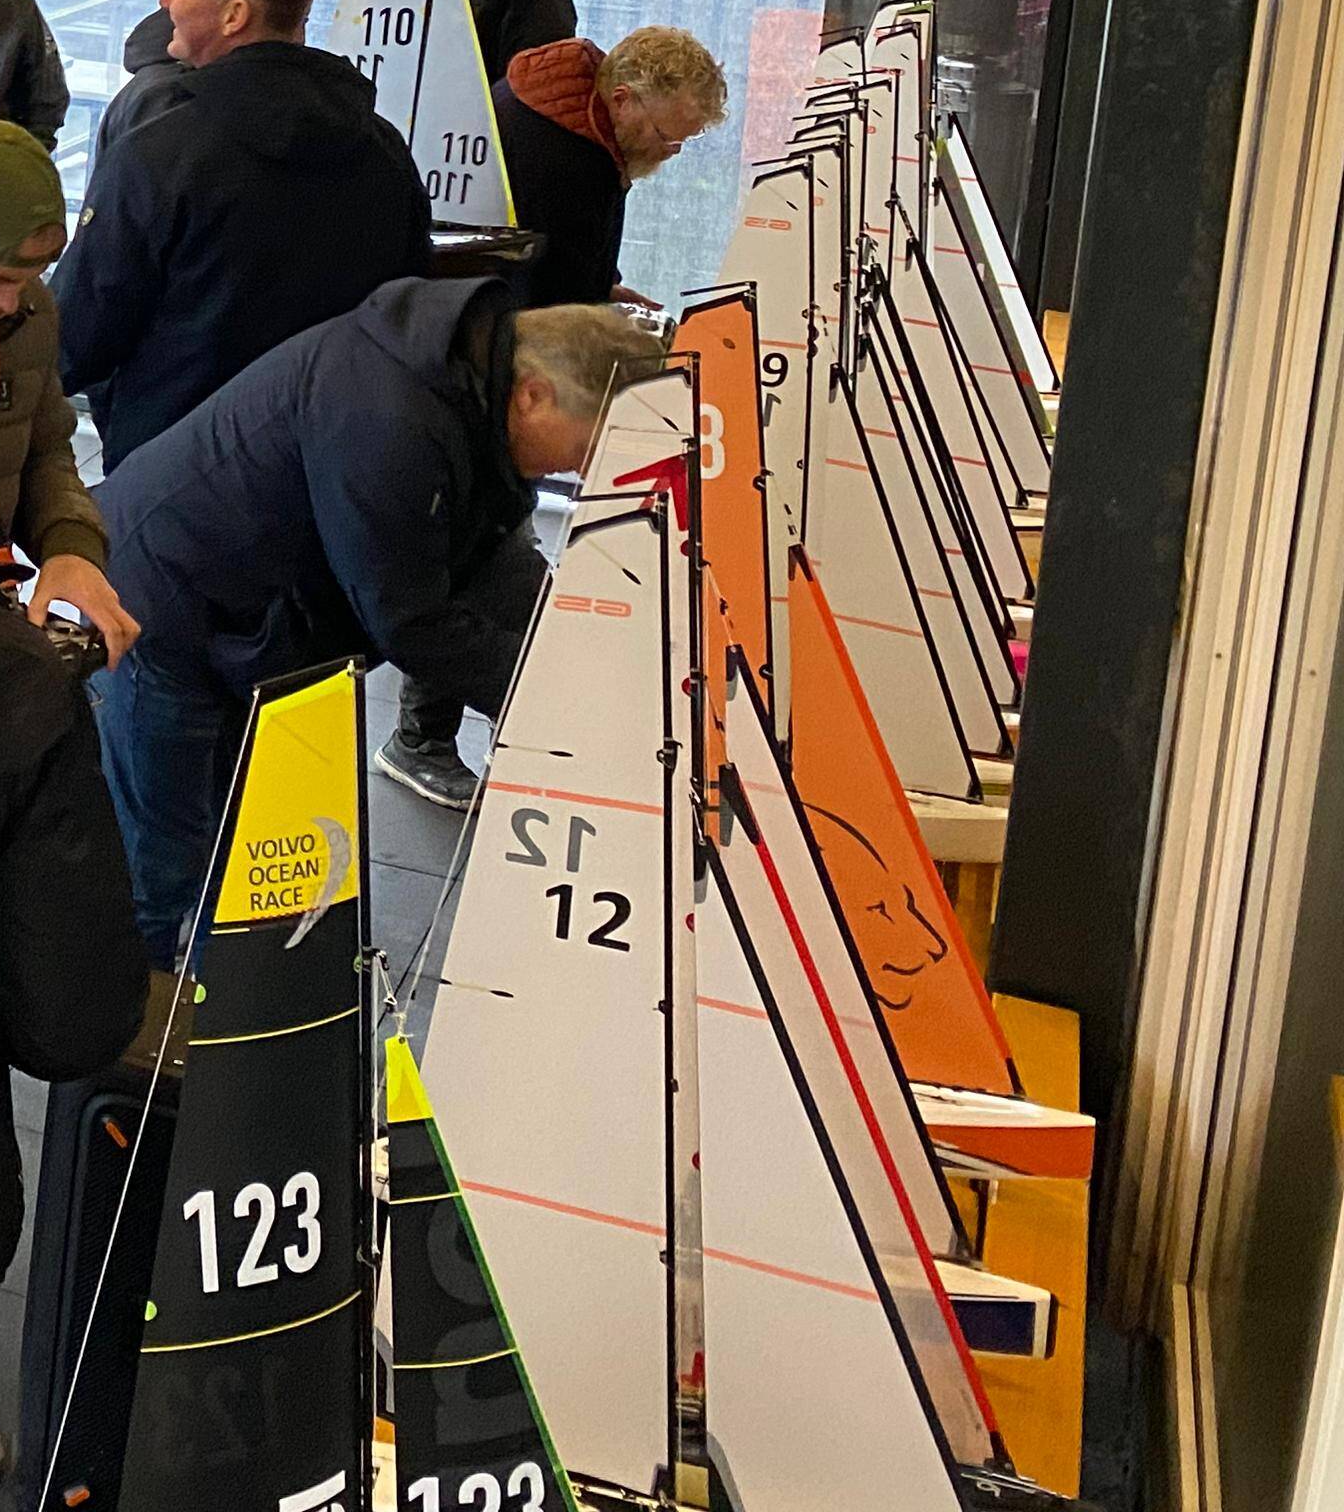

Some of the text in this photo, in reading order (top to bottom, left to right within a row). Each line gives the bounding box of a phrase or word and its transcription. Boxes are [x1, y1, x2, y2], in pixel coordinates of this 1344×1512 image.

[362, 7, 415, 46] 110
[442, 132, 489, 166] 110
[246, 834, 315, 862] VOLVO
[248, 857, 320, 886] OCEAN
[250, 887, 304, 912] RACE
[545, 883, 632, 952] 12
[183, 1171, 322, 1294] 123
